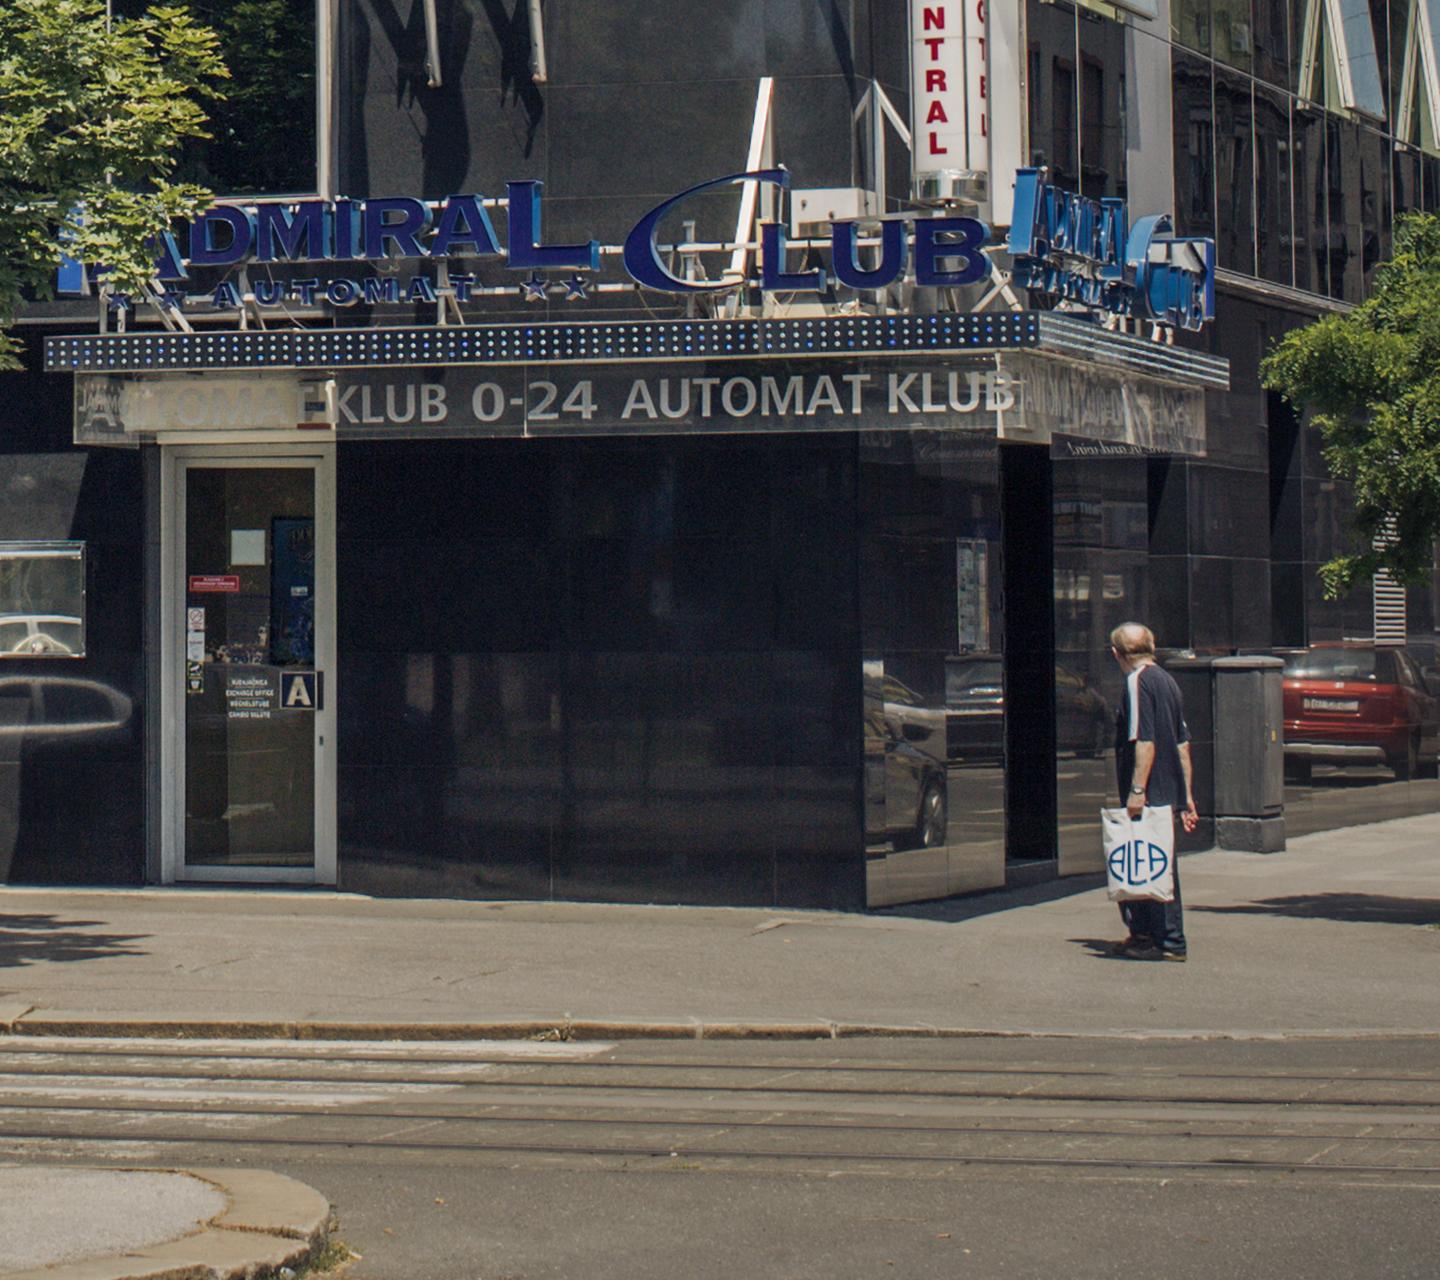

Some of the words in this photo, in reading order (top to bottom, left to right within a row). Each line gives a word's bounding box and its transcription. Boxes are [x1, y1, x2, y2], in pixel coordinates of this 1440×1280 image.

[624, 168, 992, 293] CLUB
[211, 273, 477, 308] AUTOMAT
[334, 383, 450, 425] KLUB
[471, 379, 598, 424] 0-24
[621, 372, 872, 421] AUTOMAT
[888, 369, 1017, 415] KLUB
[286, 675, 312, 707] A
[1108, 839, 1168, 886] ALFA
